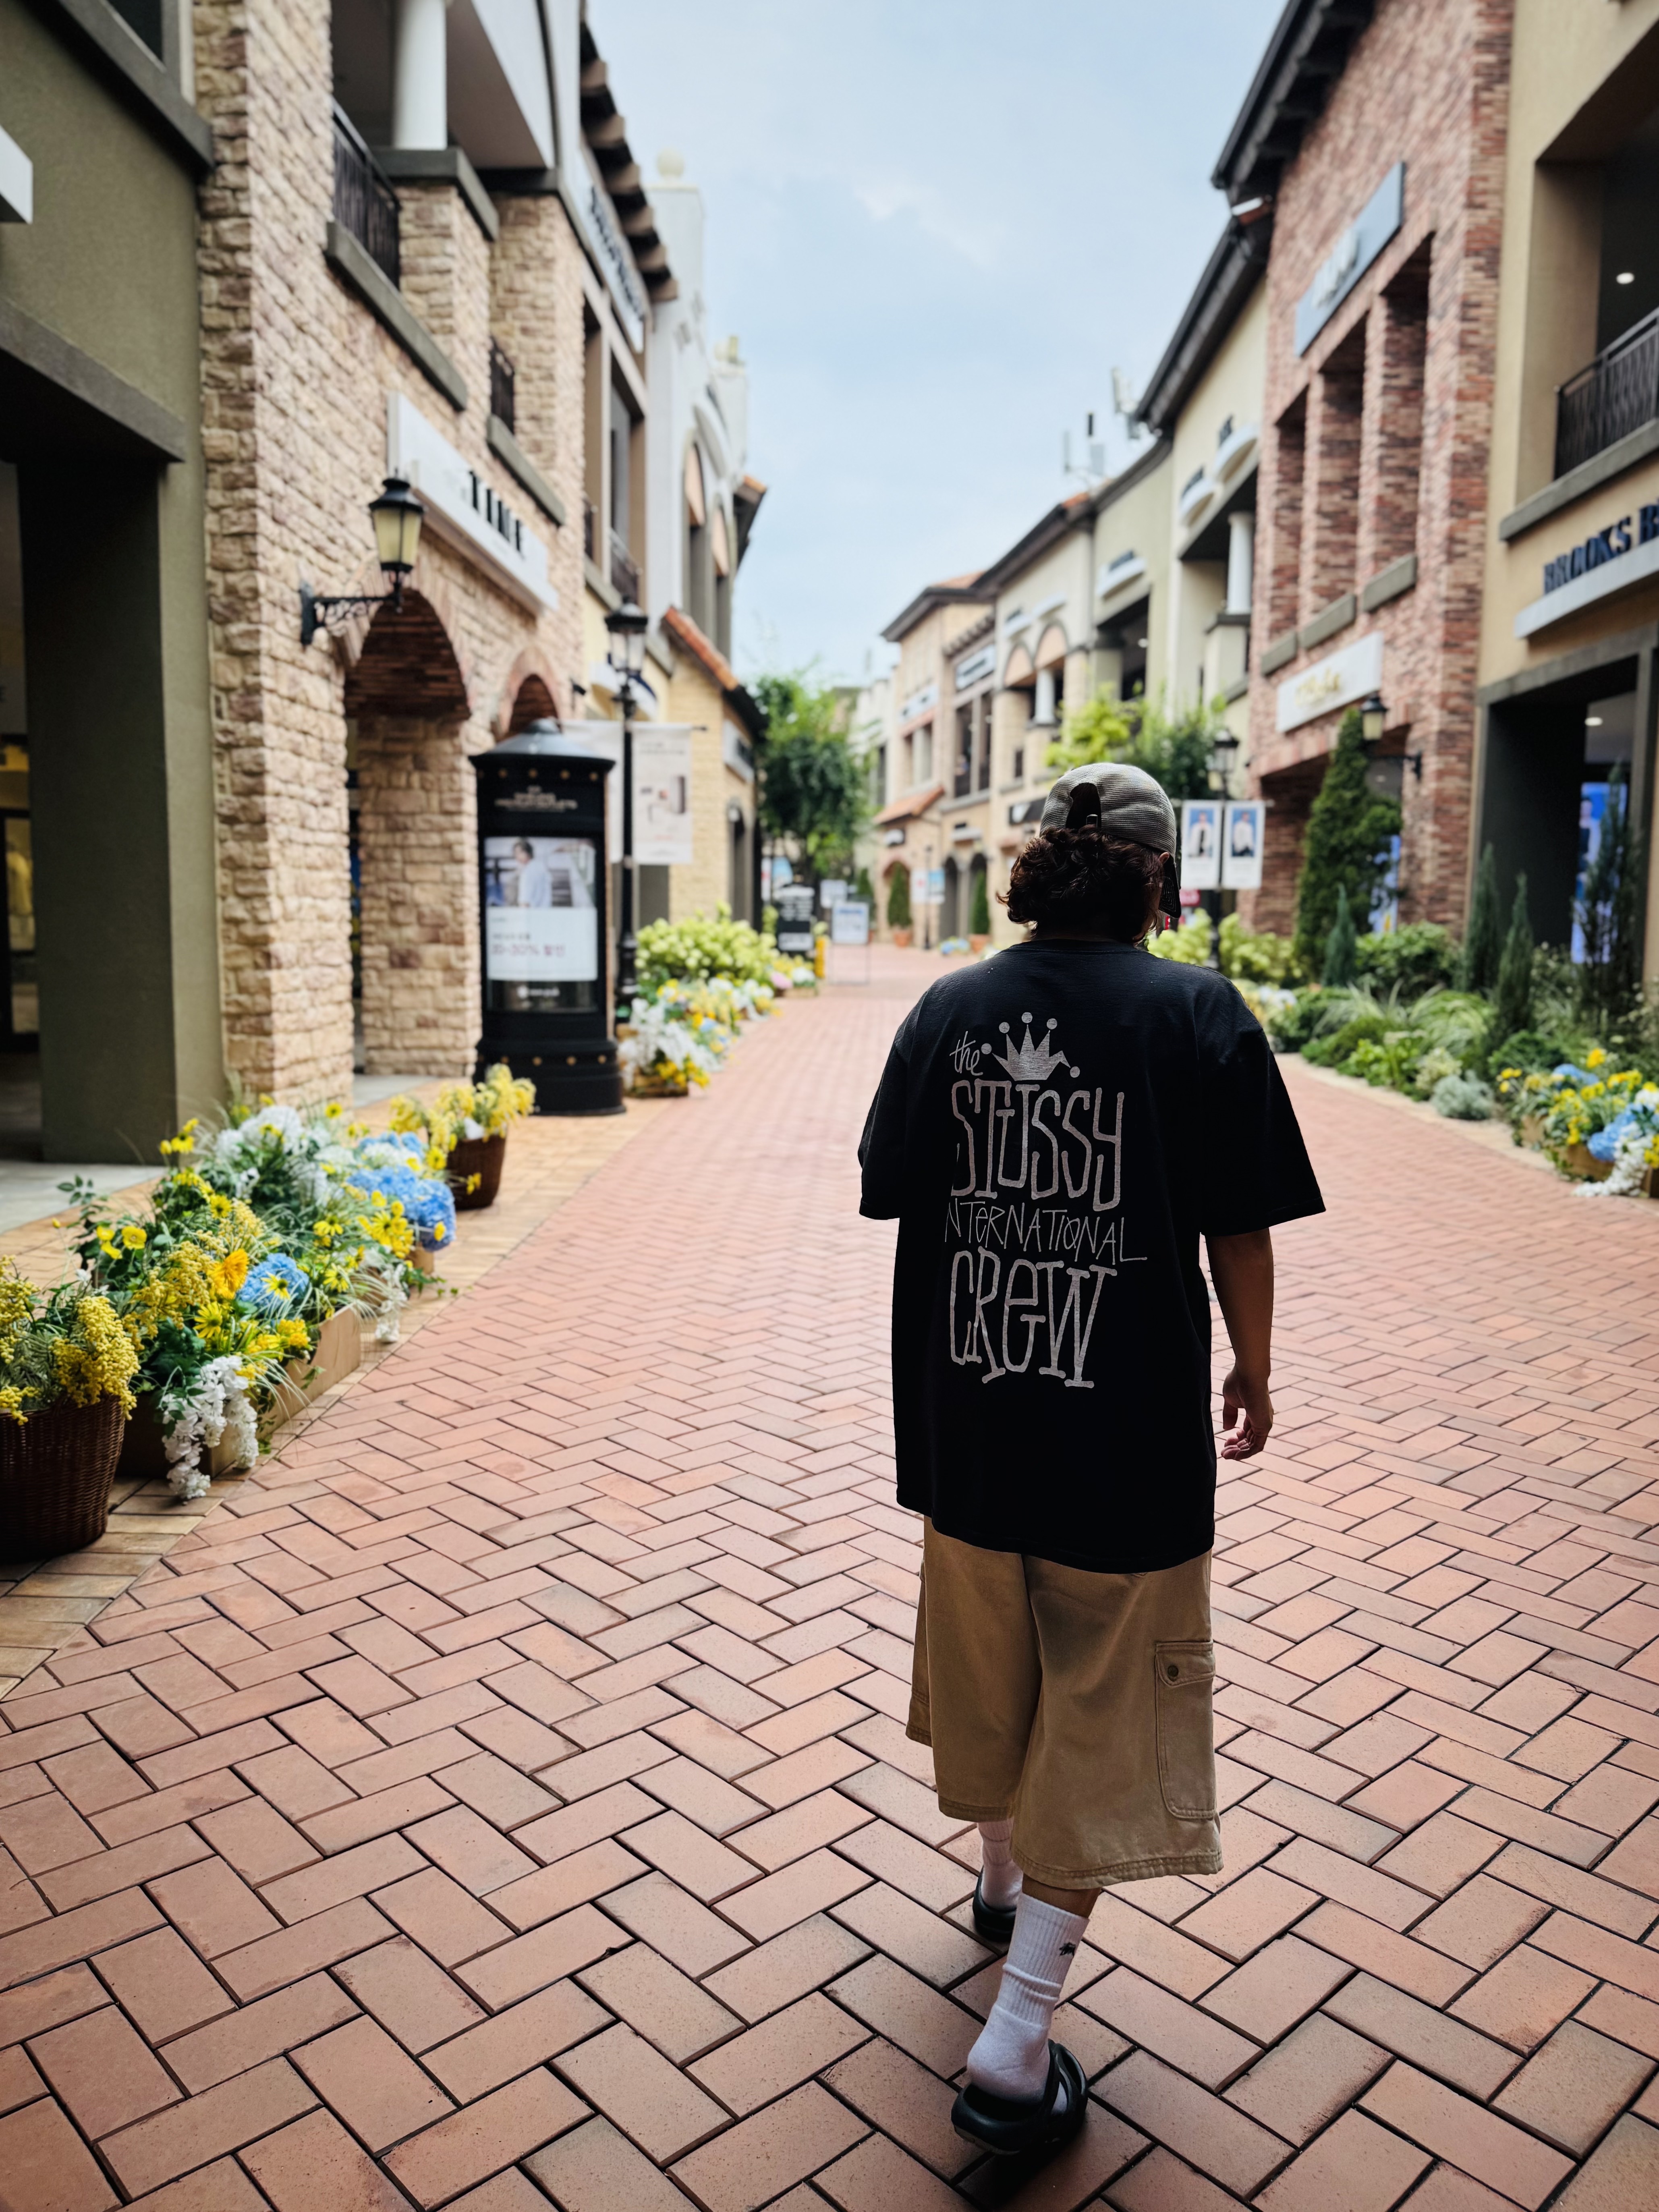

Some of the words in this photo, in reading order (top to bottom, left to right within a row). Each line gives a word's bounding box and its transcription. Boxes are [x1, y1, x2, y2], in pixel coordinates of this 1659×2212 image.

[1544, 516, 1631, 595] BROOKS
[1638, 498, 1659, 545] B
[949, 1030, 983, 1076] the
[951, 1078, 1124, 1211] STUSSY
